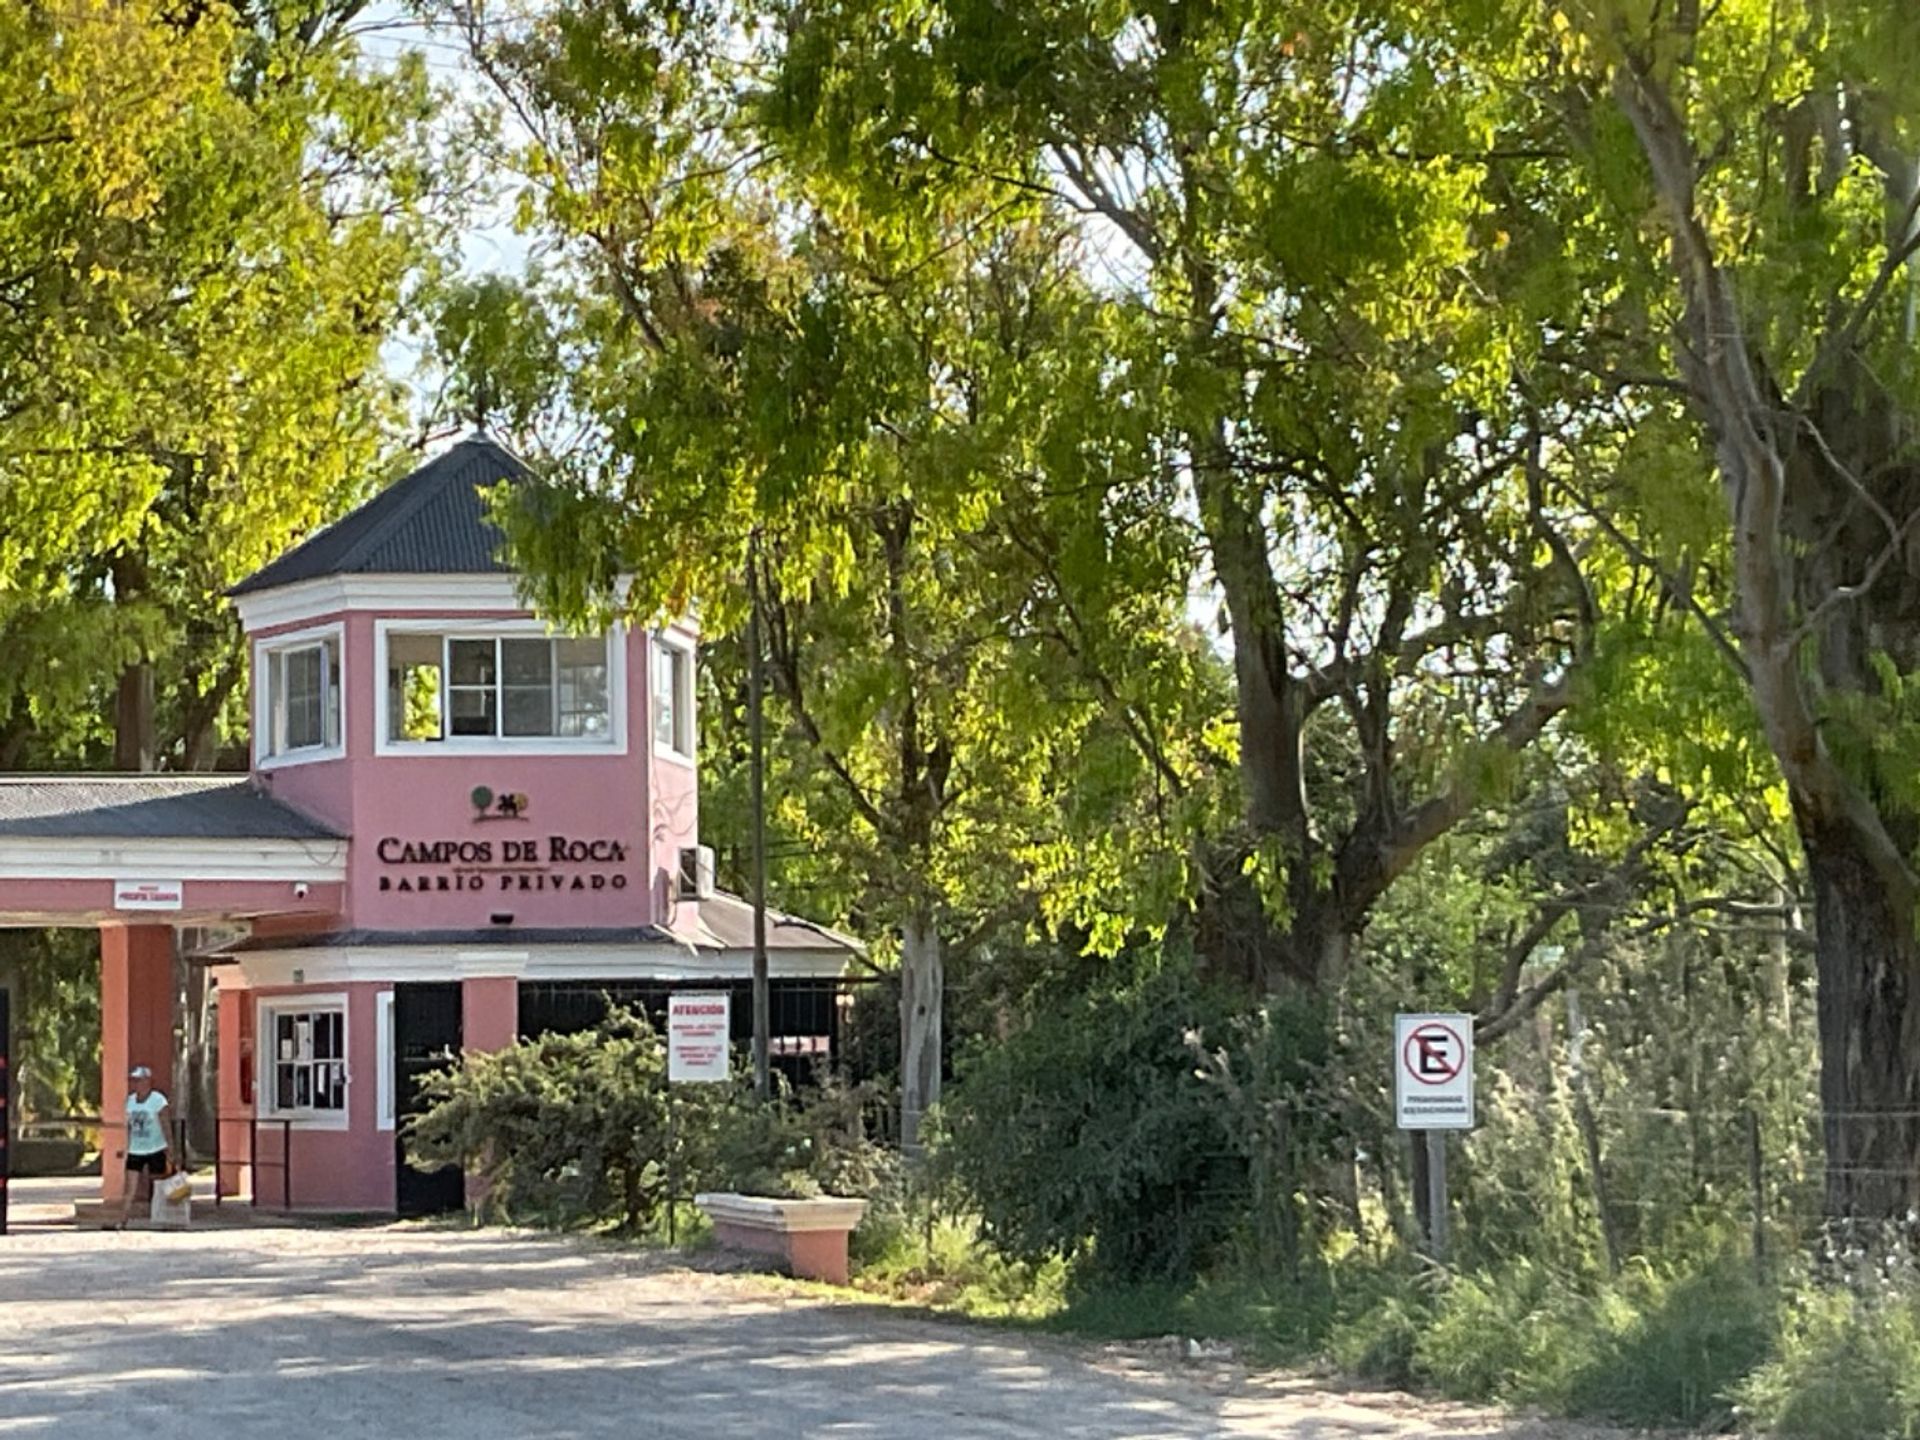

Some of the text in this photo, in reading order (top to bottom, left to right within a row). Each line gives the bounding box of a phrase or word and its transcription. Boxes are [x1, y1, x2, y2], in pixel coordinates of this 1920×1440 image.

[377, 836, 626, 864] CAMPOS DE ROCA
[500, 874, 628, 890] PRIVADO
[1420, 1035, 1450, 1074] E
